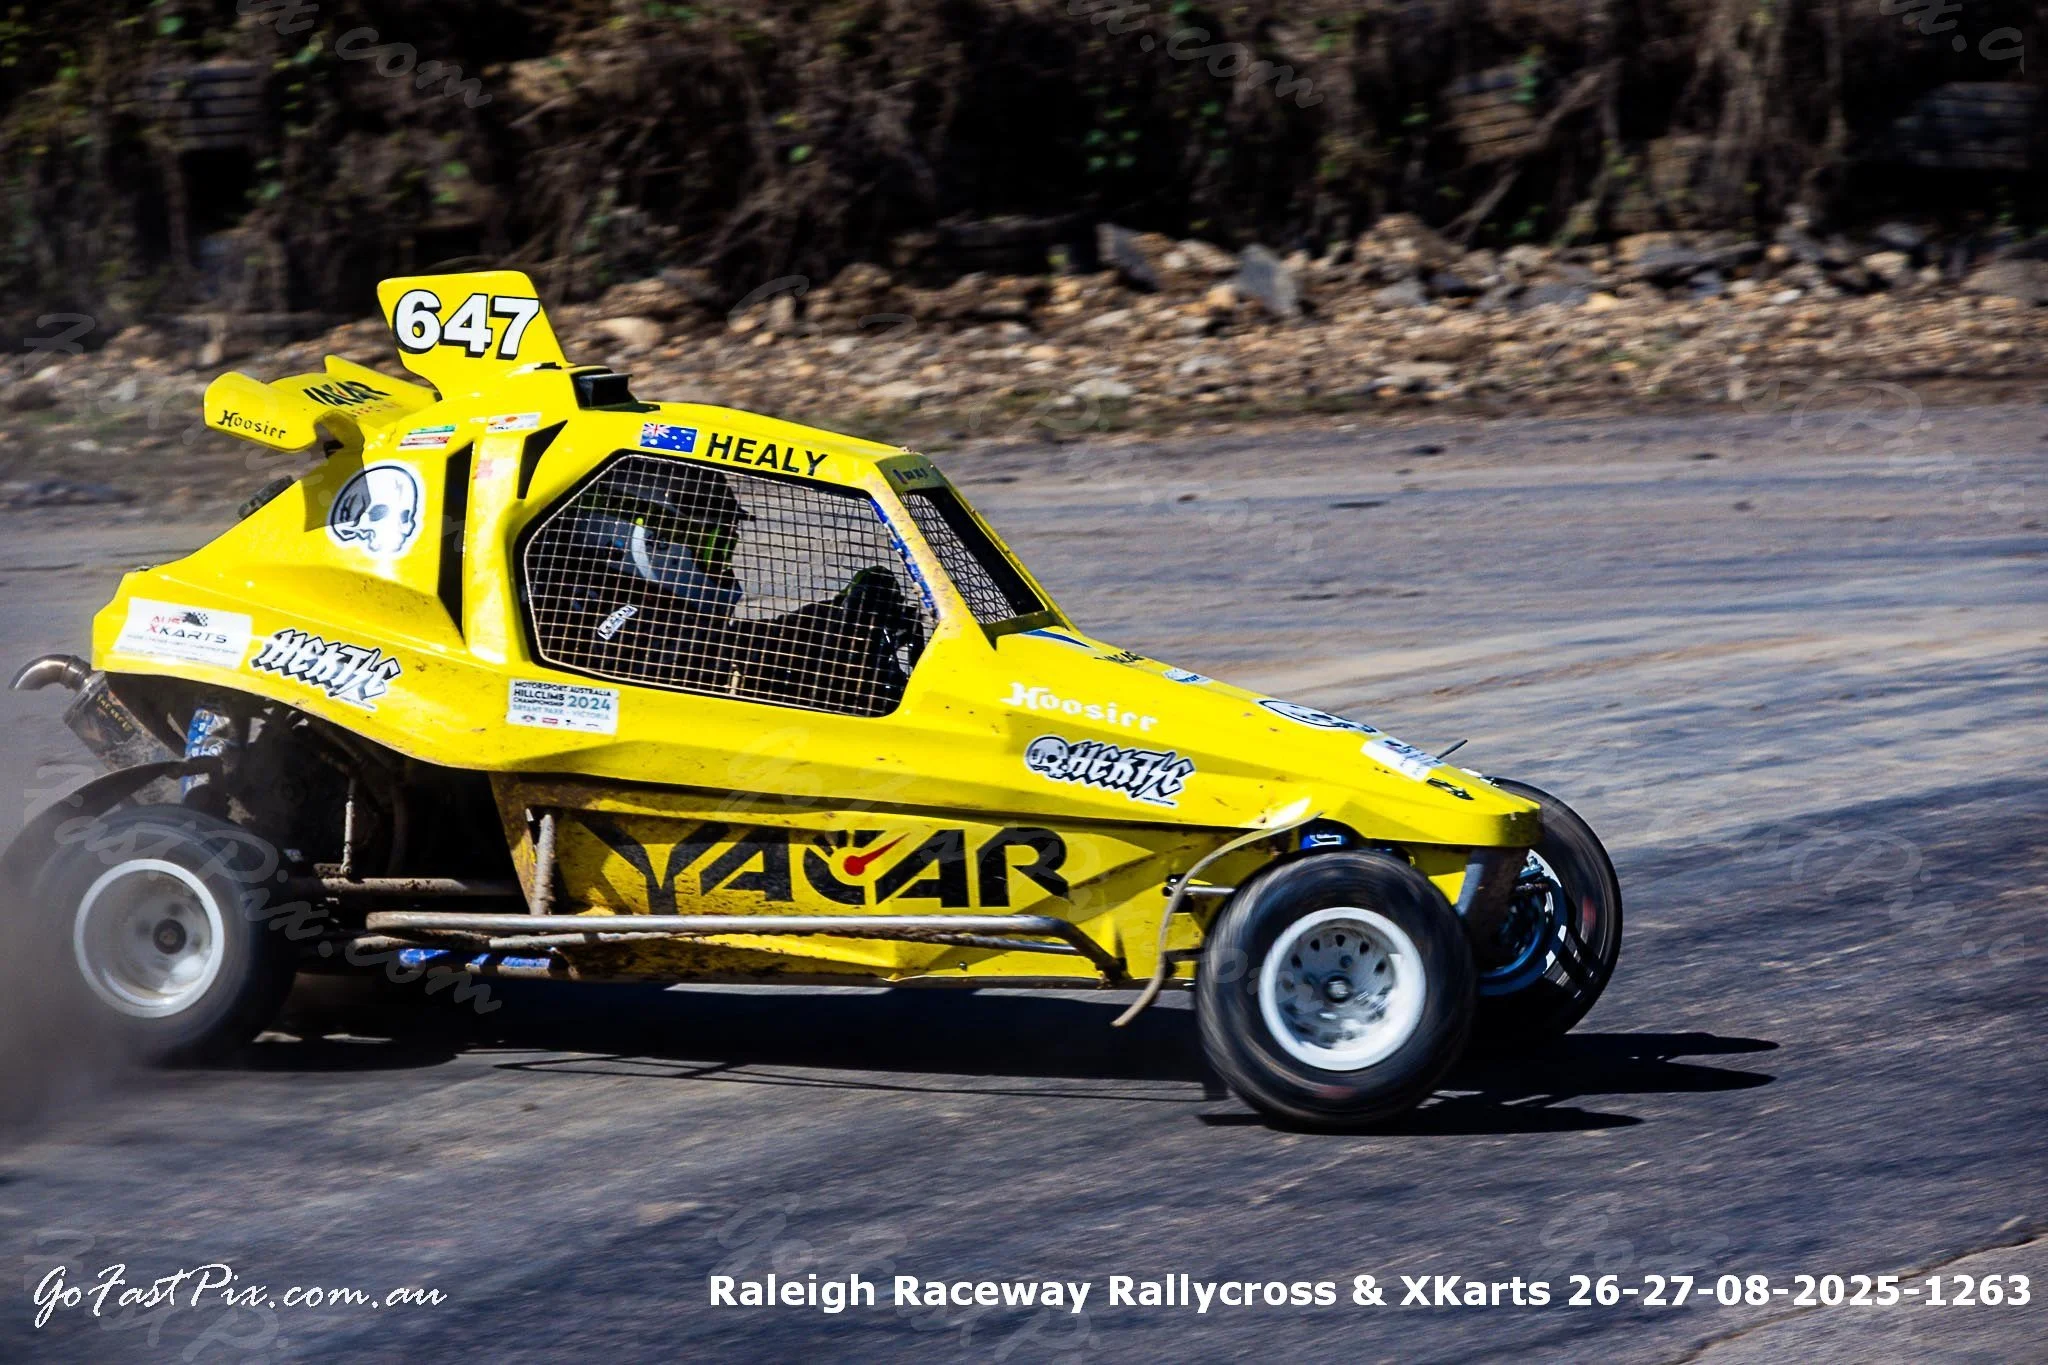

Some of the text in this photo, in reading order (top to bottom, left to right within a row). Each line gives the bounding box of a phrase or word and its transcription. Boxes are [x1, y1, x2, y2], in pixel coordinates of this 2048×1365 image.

[391, 287, 541, 361] 647
[216, 409, 287, 440] Hoosier
[705, 432, 828, 477] HEALY
[514, 682, 611, 697] MOTORSPORT AUSTRALIA
[514, 689, 611, 710] HILLCLIMB 2024
[1000, 681, 1159, 733] Hoosier
